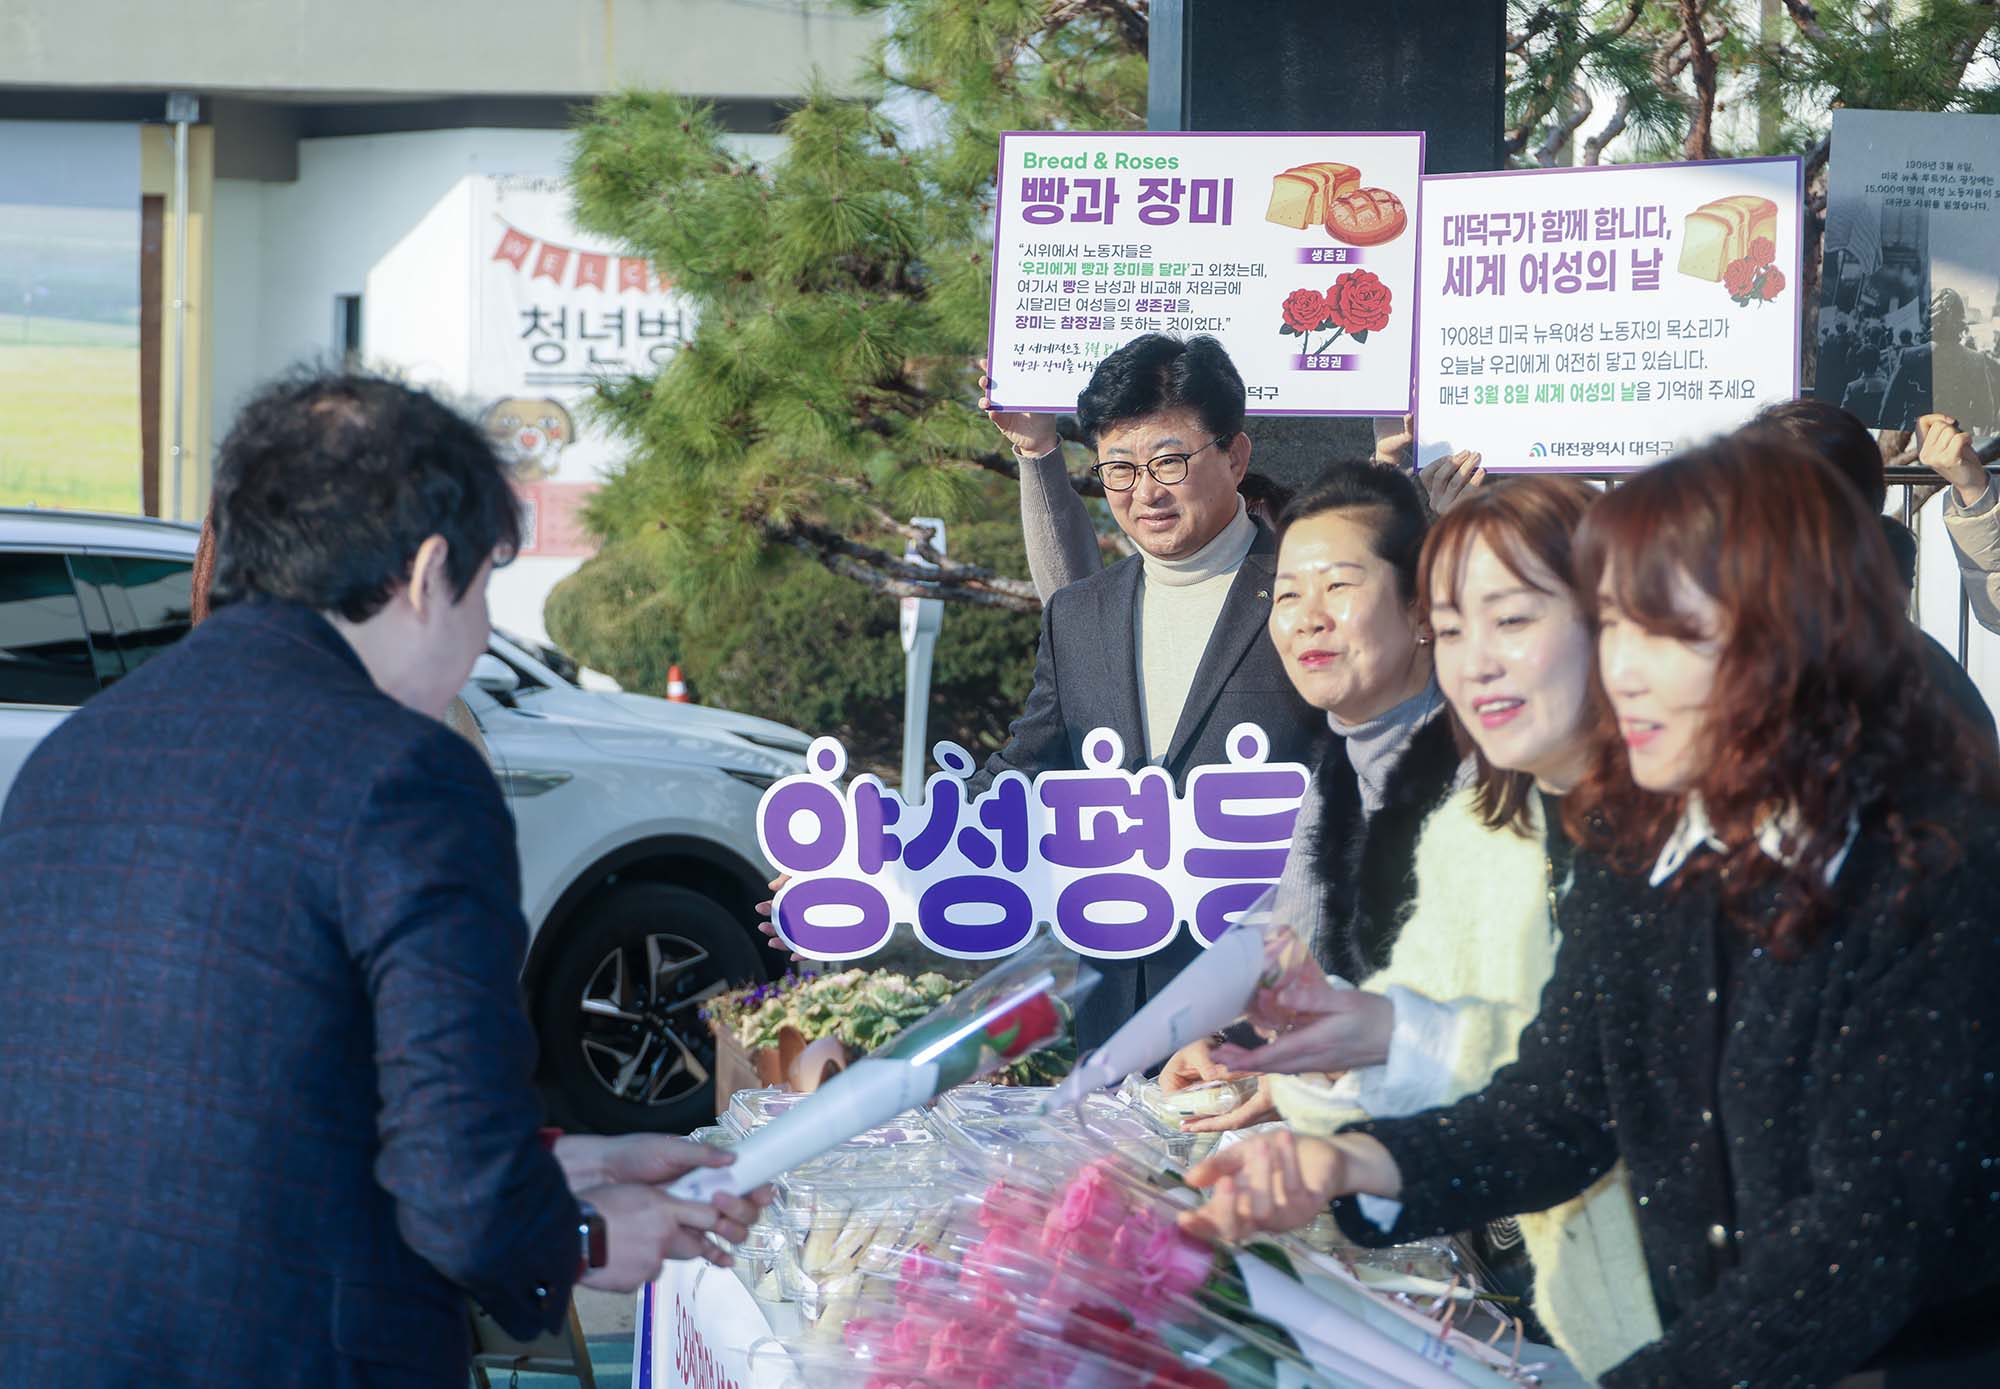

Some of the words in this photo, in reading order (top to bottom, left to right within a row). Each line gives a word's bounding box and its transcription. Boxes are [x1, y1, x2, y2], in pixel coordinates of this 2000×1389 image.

[1023, 151, 1088, 170] Bread
[1093, 152, 1108, 170] &
[1115, 152, 1180, 171] Roses
[1905, 160, 1937, 170] 1908년
[1881, 171, 1898, 181] 미국
[1021, 176, 1121, 226] 빵과
[1137, 177, 1234, 227] 장미
[1443, 211, 1536, 246] 대덕구가
[1542, 208, 1588, 244] 함께
[1083, 243, 1152, 259] 노동자들은
[1311, 248, 1347, 263] 생존권
[1082, 262, 1109, 277] 빵과
[1113, 262, 1154, 278] 장미를
[1208, 263, 1268, 279] 외쳤는데,
[1442, 253, 1506, 298] 세계
[1519, 249, 1616, 296] 여성의
[1630, 247, 1664, 292] 날
[1017, 279, 1058, 294] 여기서
[1063, 279, 1090, 295] 빵은
[1094, 280, 1136, 295] 남성과
[1141, 280, 1181, 295] 비교해
[1186, 281, 1242, 296] 저임금에
[1016, 297, 1071, 312] 시달리던
[1075, 298, 1131, 313] 여성들의
[1135, 298, 1194, 315] 생존권을,
[1015, 315, 1056, 330] 장미는
[1060, 315, 1116, 331] 참정권을
[1120, 316, 1162, 331] 뜻하는
[1440, 324, 1494, 346] 1908년
[1499, 323, 1528, 345] 미국
[1533, 321, 1594, 344] 뉴욕여성
[1599, 319, 1662, 342] 노동자의
[1666, 317, 1730, 340] 목소리가
[520, 304, 683, 366] 청년벙
[1013, 343, 1025, 355] 전
[1028, 342, 1081, 355] 세계적으로
[1013, 360, 1040, 372] 빵과
[1042, 358, 1074, 374] 장미를
[1306, 354, 1342, 369] 참정권
[1439, 354, 1485, 376] 오늘날
[1489, 352, 1551, 375] 우리에게
[1555, 350, 1601, 373] 여전히
[1605, 349, 1636, 371] 닿고
[1642, 348, 1708, 371] 있습니다.
[1247, 386, 1279, 400] 덕구
[1439, 383, 1469, 406] 매년
[1473, 383, 1500, 405] 3월
[1504, 382, 1529, 404] 8일
[1534, 381, 1565, 403] 세계
[1569, 380, 1615, 403] 여성의
[1620, 379, 1652, 402] 날을
[1656, 378, 1702, 401] 기억해
[1707, 378, 1756, 399] 주세요
[1551, 441, 1625, 457] 대전광역시
[1629, 440, 1674, 456] 대덕구
[762, 728, 1308, 956] 양성평등
